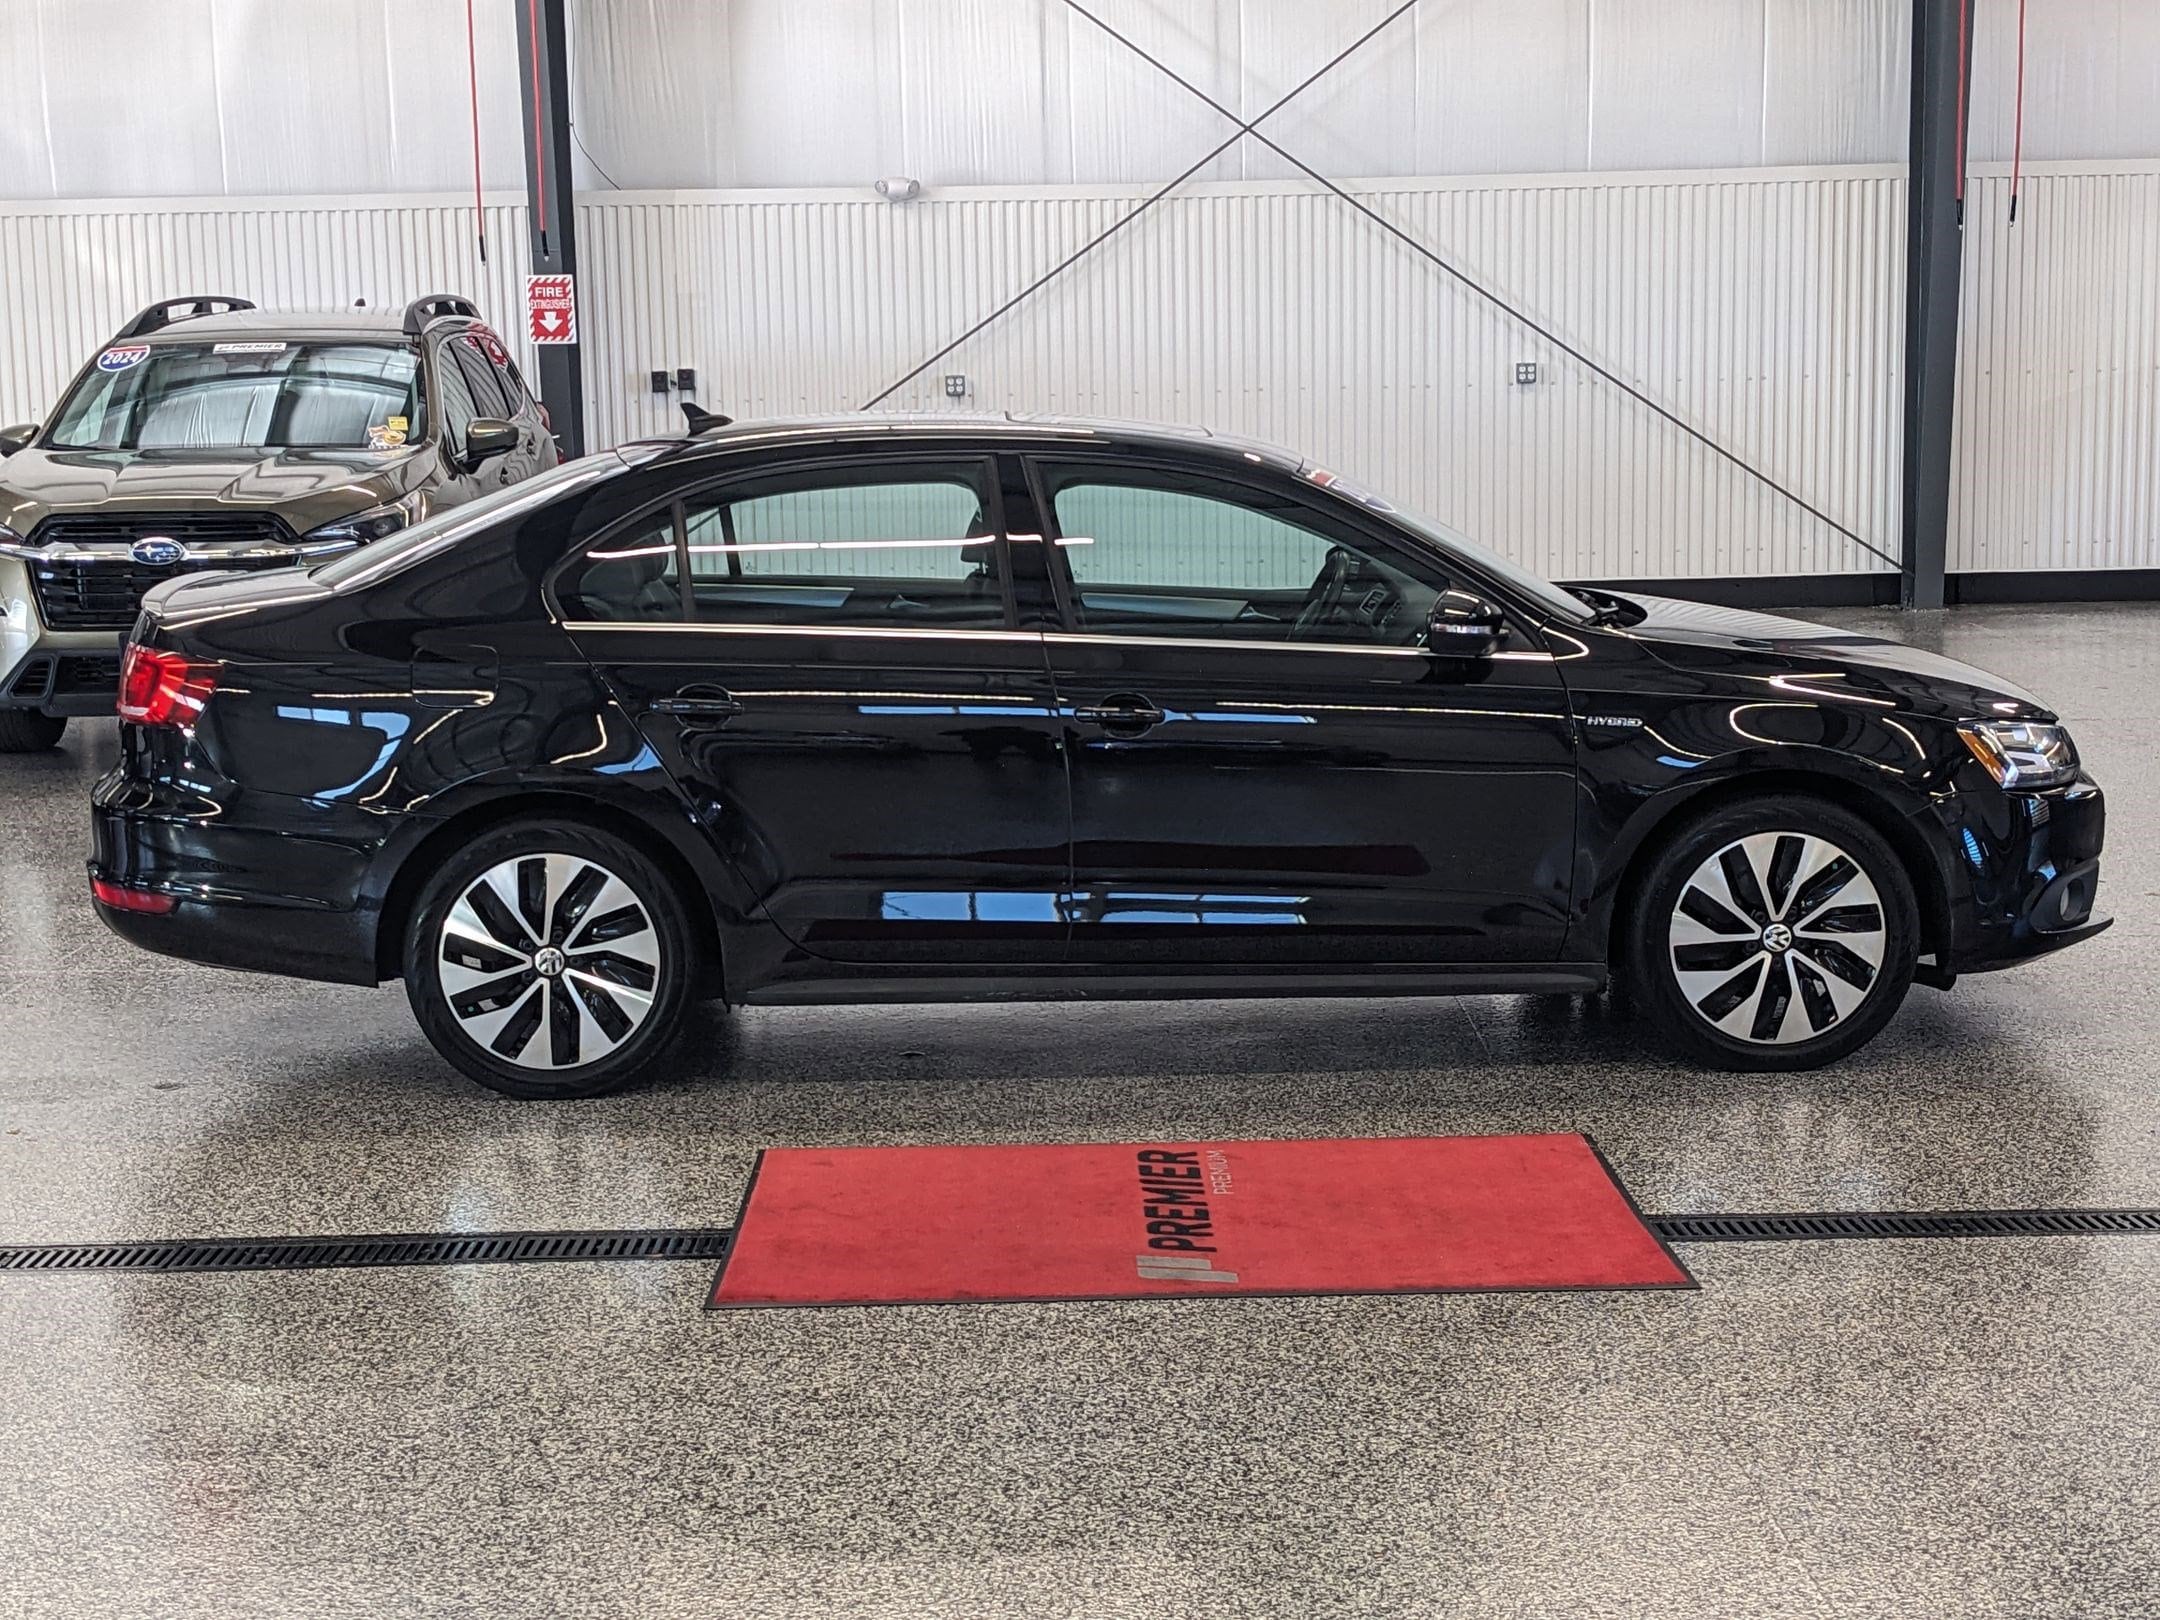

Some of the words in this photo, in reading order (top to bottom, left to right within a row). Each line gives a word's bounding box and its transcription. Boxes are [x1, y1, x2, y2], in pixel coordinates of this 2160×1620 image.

[534, 286, 563, 297] FIRE
[102, 351, 142, 365] 2024
[1586, 716, 1643, 727] HYBRID
[1206, 1149, 1234, 1194] PREMIUM
[1137, 1149, 1217, 1252] PREMIER
